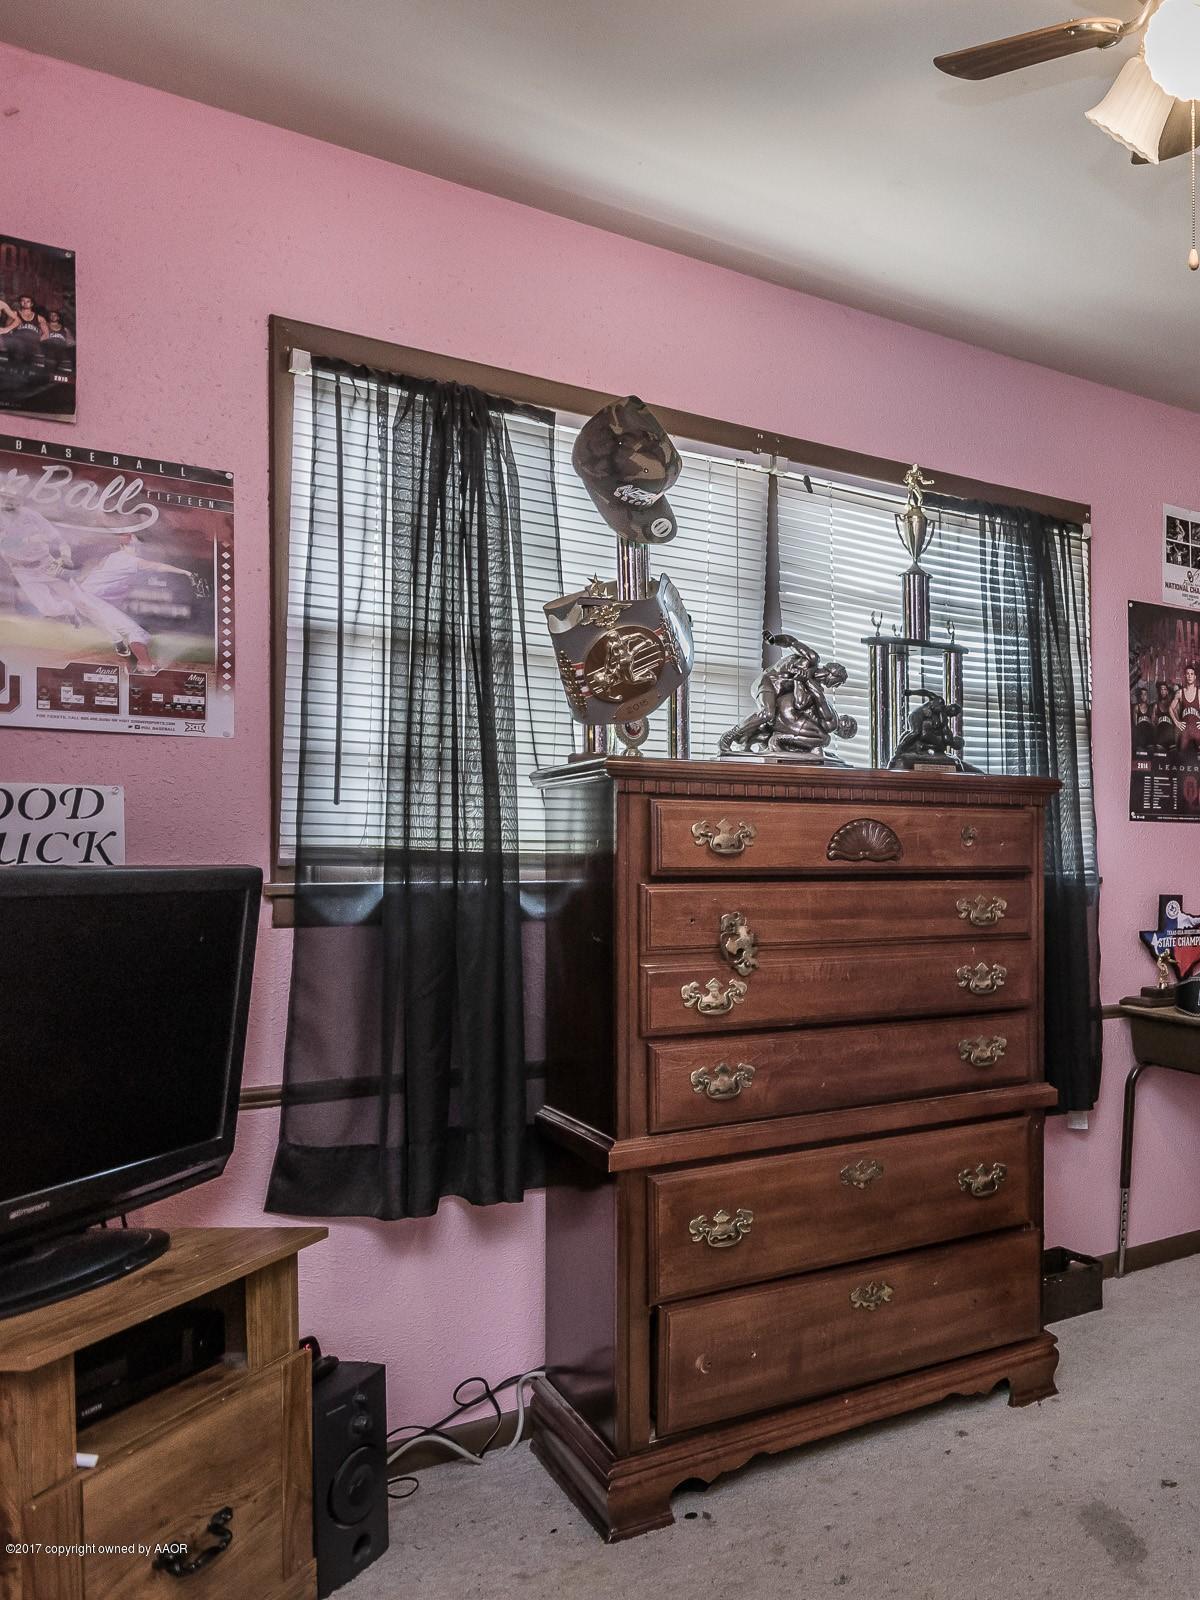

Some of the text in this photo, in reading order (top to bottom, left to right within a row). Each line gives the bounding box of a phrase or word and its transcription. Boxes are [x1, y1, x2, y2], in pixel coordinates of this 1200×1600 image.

[16, 440, 186, 477] BASEBALL
[147, 491, 214, 508] FIFTEEN
[188, 674, 204, 684] May
[1159, 937, 1176, 948] STATE
